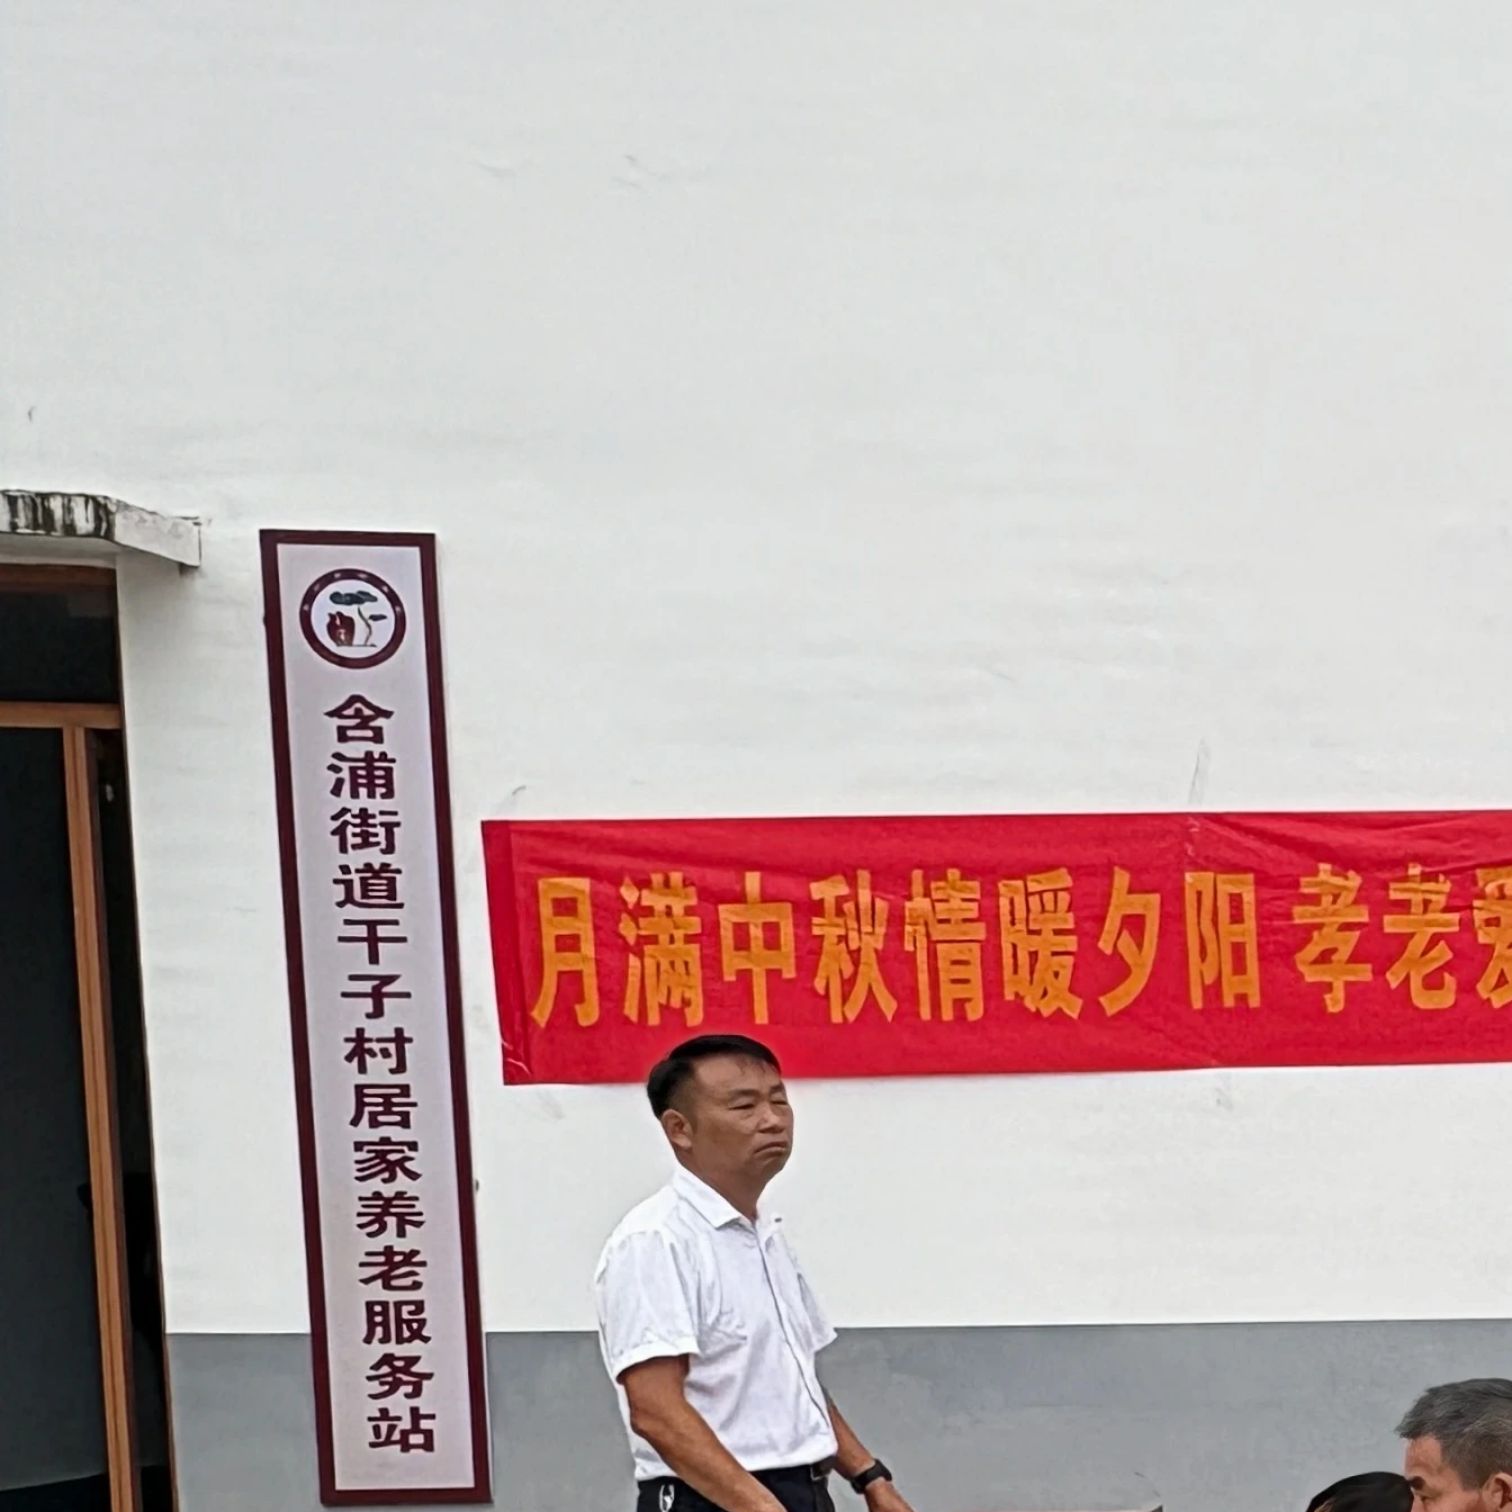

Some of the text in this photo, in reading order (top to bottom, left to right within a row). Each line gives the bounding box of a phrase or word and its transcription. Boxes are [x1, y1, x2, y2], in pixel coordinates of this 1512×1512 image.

[324, 694, 436, 1454] 含浦街道干子村居家养老服务站
